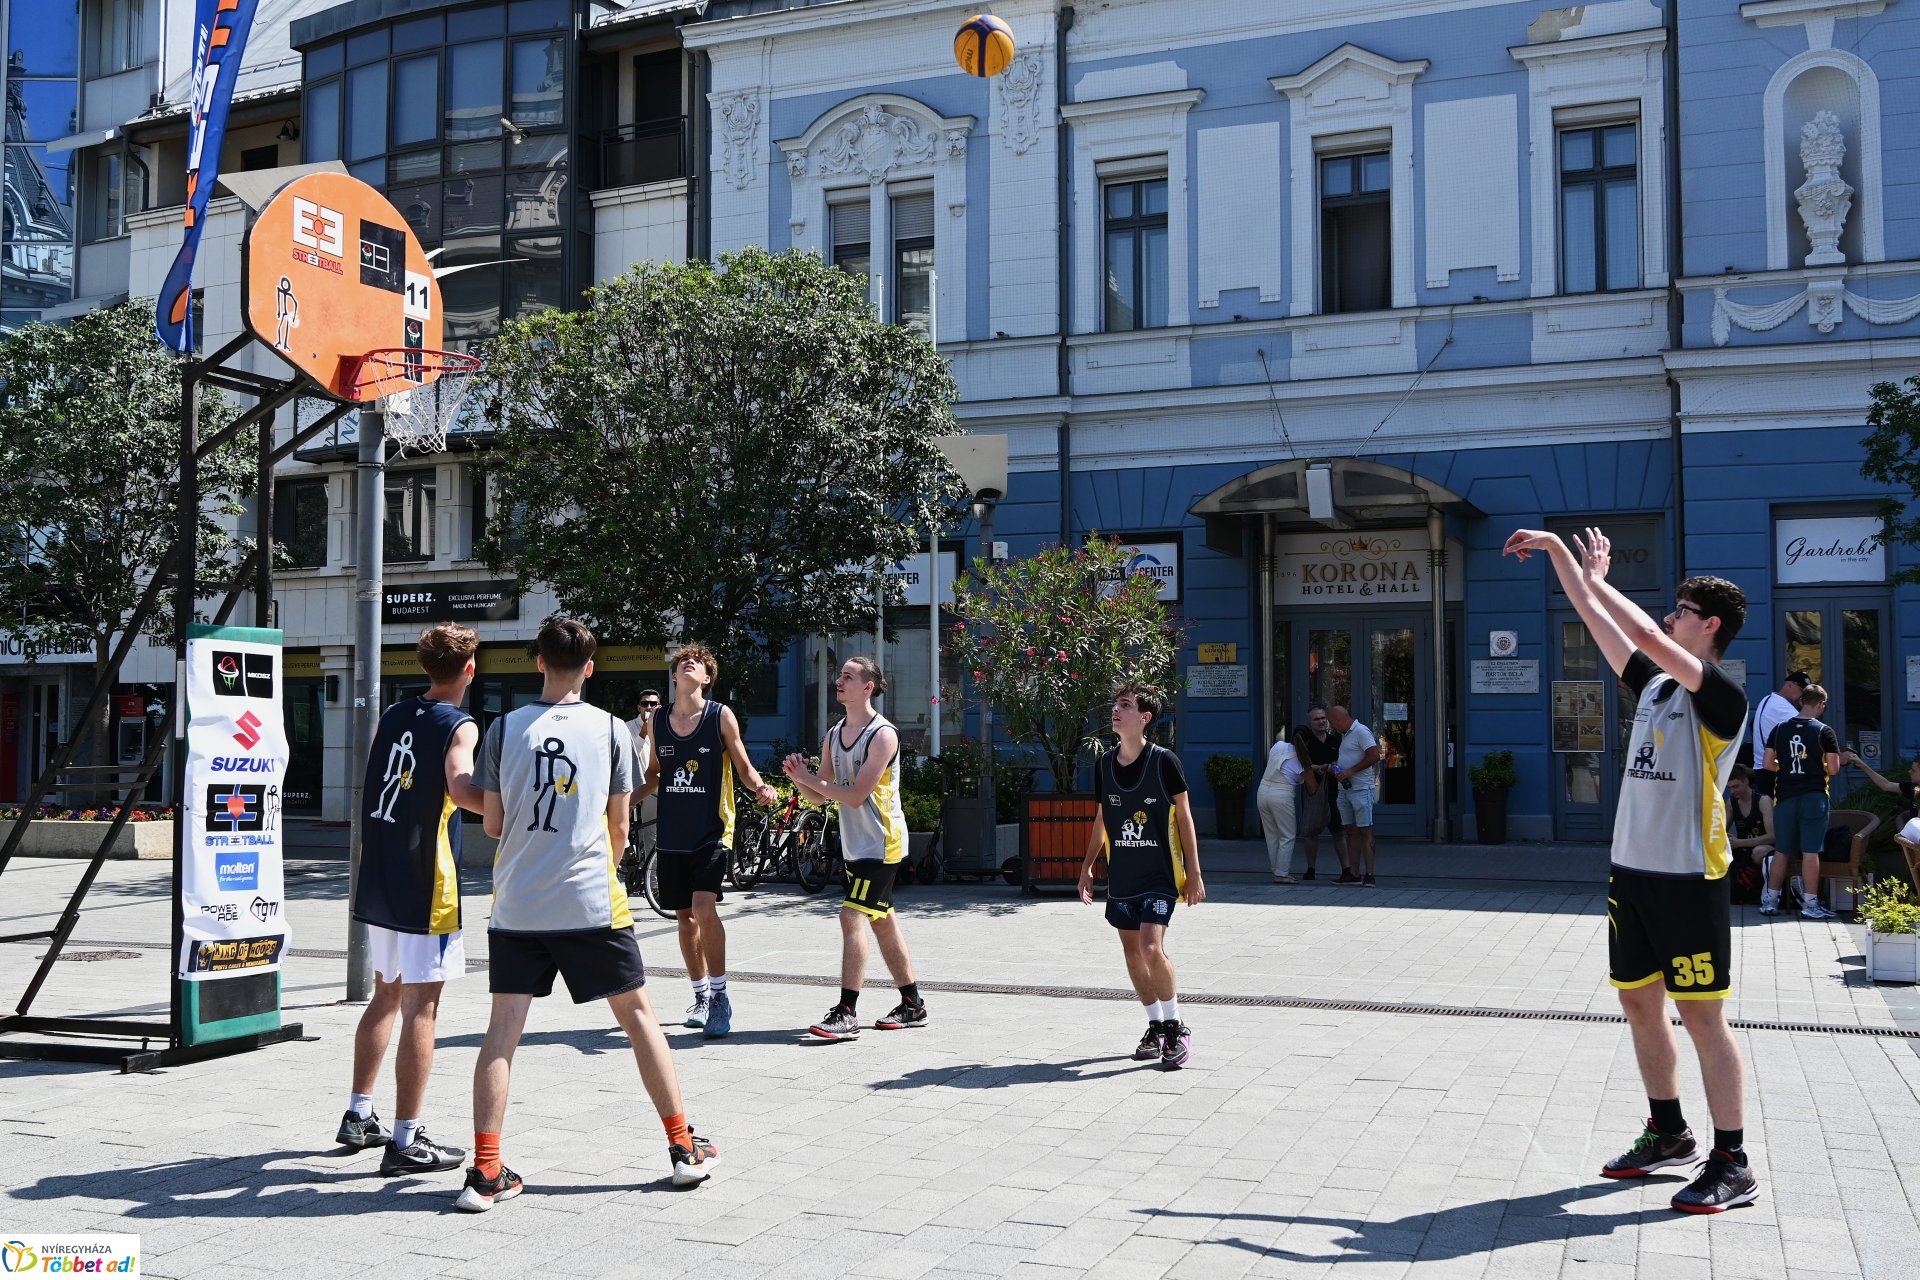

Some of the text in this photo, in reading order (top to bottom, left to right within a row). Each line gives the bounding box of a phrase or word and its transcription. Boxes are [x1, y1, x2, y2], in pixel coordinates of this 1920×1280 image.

[406, 282, 428, 309] 11
[1785, 536, 1876, 565] Gardrobe
[1302, 561, 1420, 583] KORONA
[1302, 582, 1420, 596] HOTEL & HALL
[386, 593, 436, 603] SUPERZ.
[392, 606, 429, 614] BUDAPEST
[211, 757, 274, 772] SUZUKI
[1114, 840, 1158, 848] STREETBALL
[220, 862, 255, 874] molten
[850, 878, 871, 900] 11
[201, 904, 237, 914] POWER
[218, 913, 238, 921] ADE
[213, 941, 277, 959] KING OF HOOPS
[1672, 952, 1715, 988] 35
